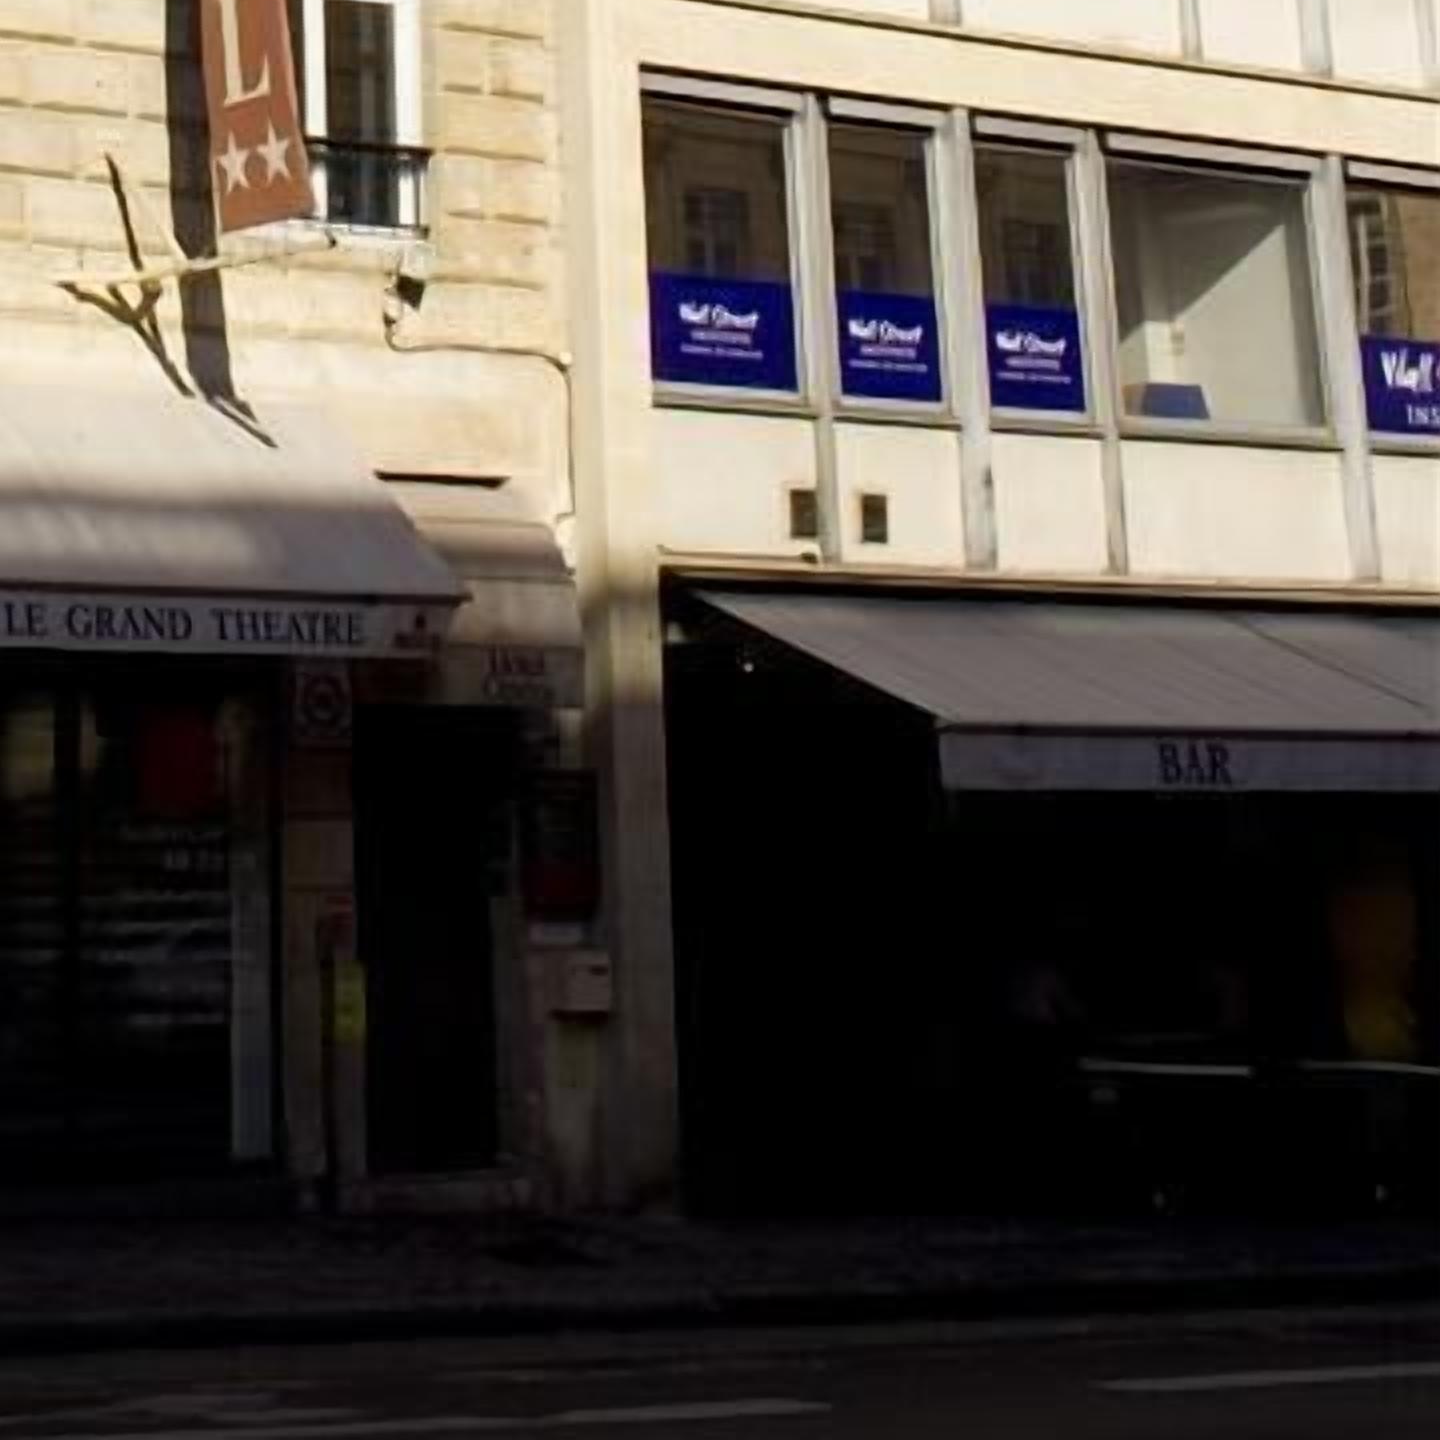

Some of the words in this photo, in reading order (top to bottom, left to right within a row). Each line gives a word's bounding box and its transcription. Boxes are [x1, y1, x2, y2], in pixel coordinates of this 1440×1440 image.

[4, 601, 48, 638] LE
[66, 603, 193, 641] GRAND
[210, 606, 367, 646] THEATRE
[1159, 743, 1232, 785] BAR
